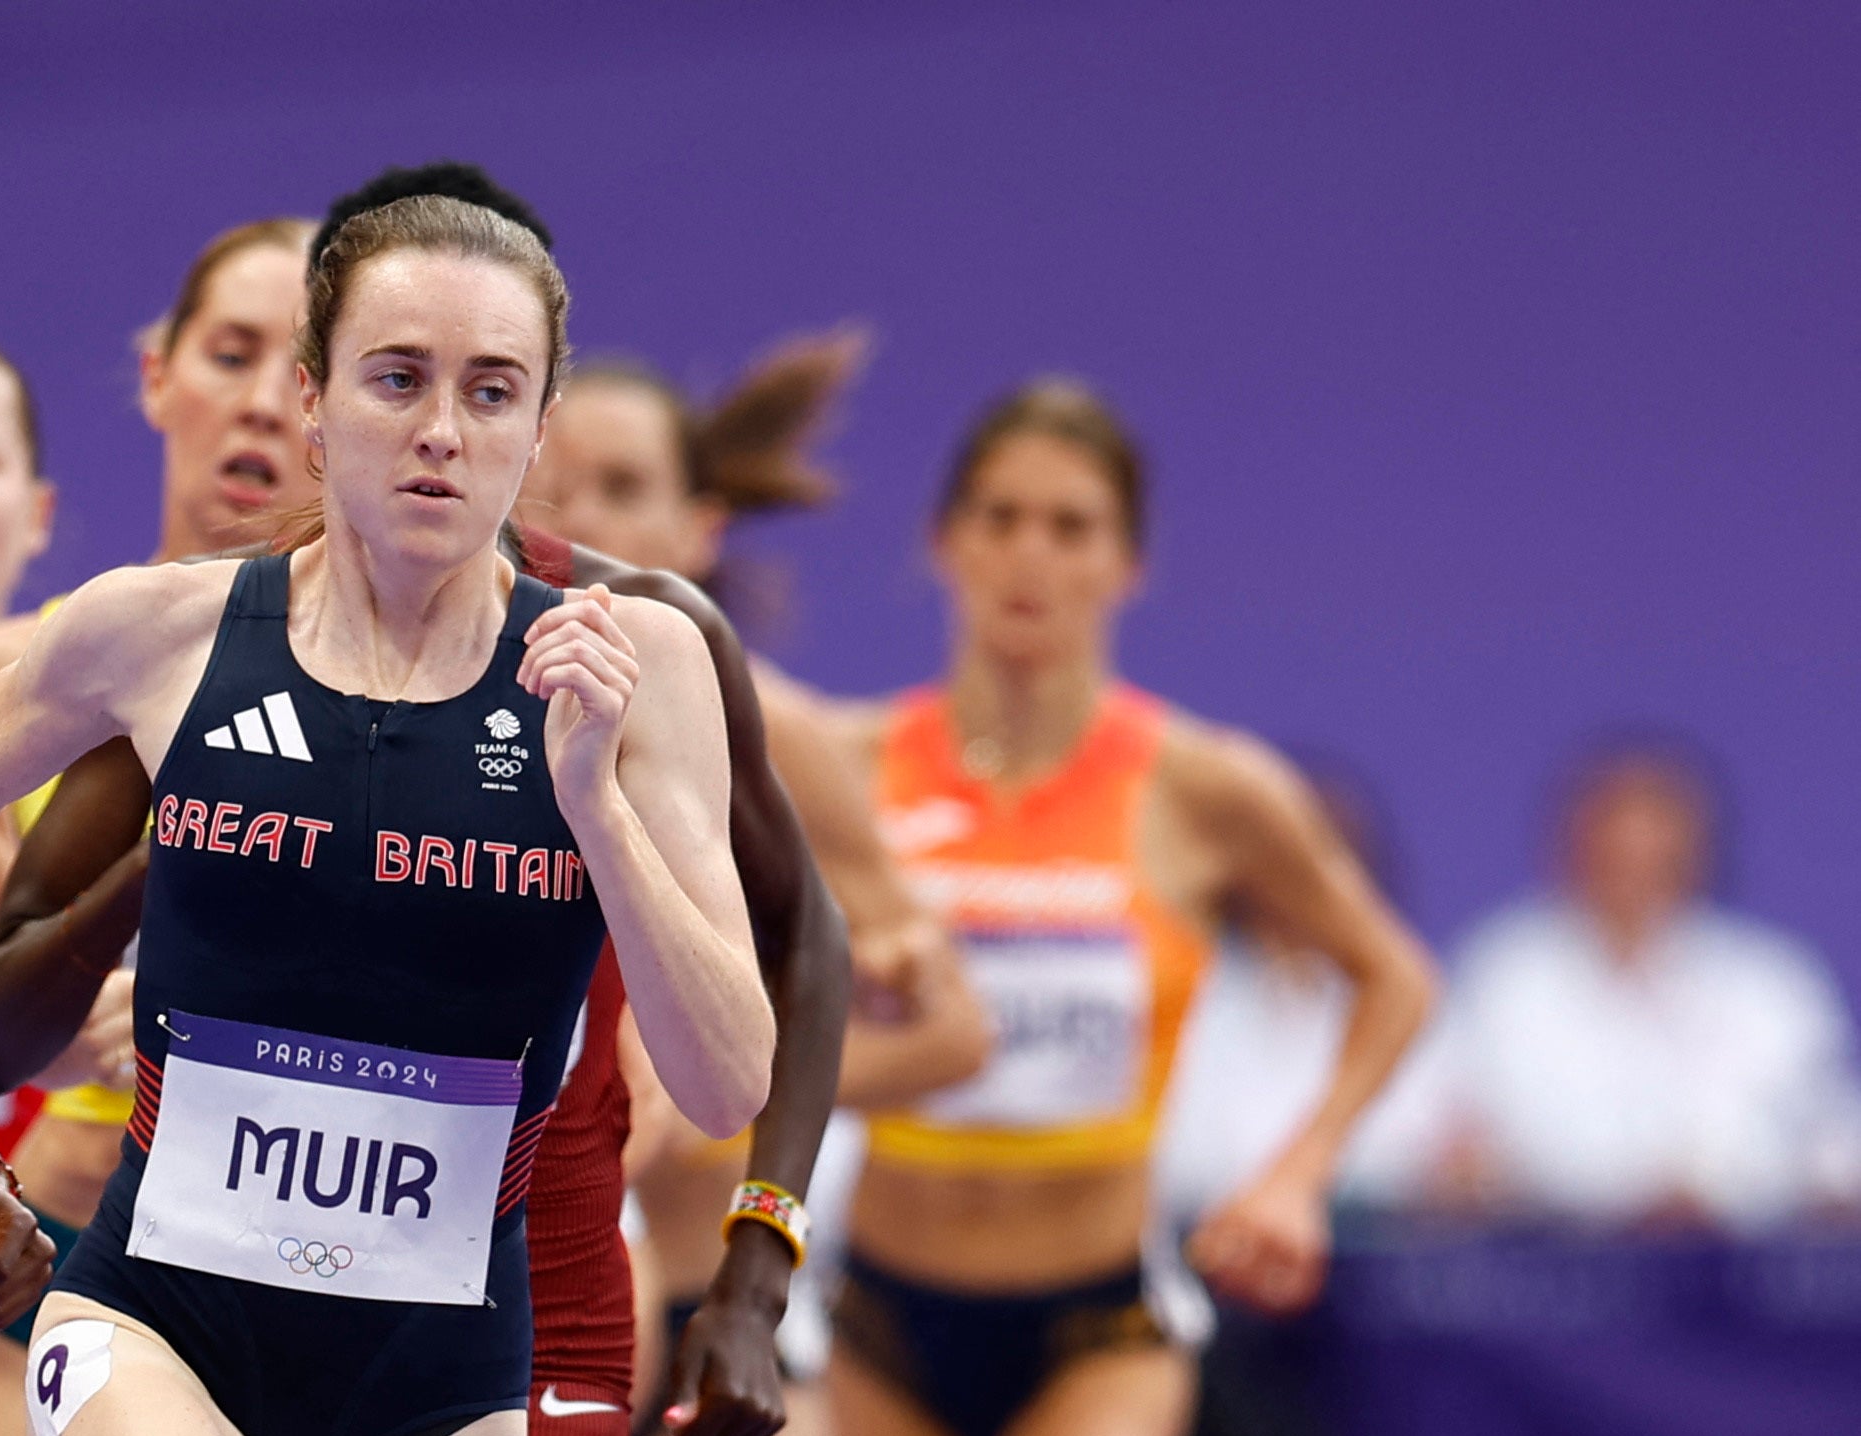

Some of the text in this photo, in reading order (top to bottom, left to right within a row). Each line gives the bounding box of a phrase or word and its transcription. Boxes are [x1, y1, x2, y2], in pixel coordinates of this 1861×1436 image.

[474, 743, 529, 760] TEAM GB
[157, 794, 585, 901] GREAT BRITAIN
[356, 1057, 437, 1088] 2024
[226, 1116, 438, 1219] MUIR
